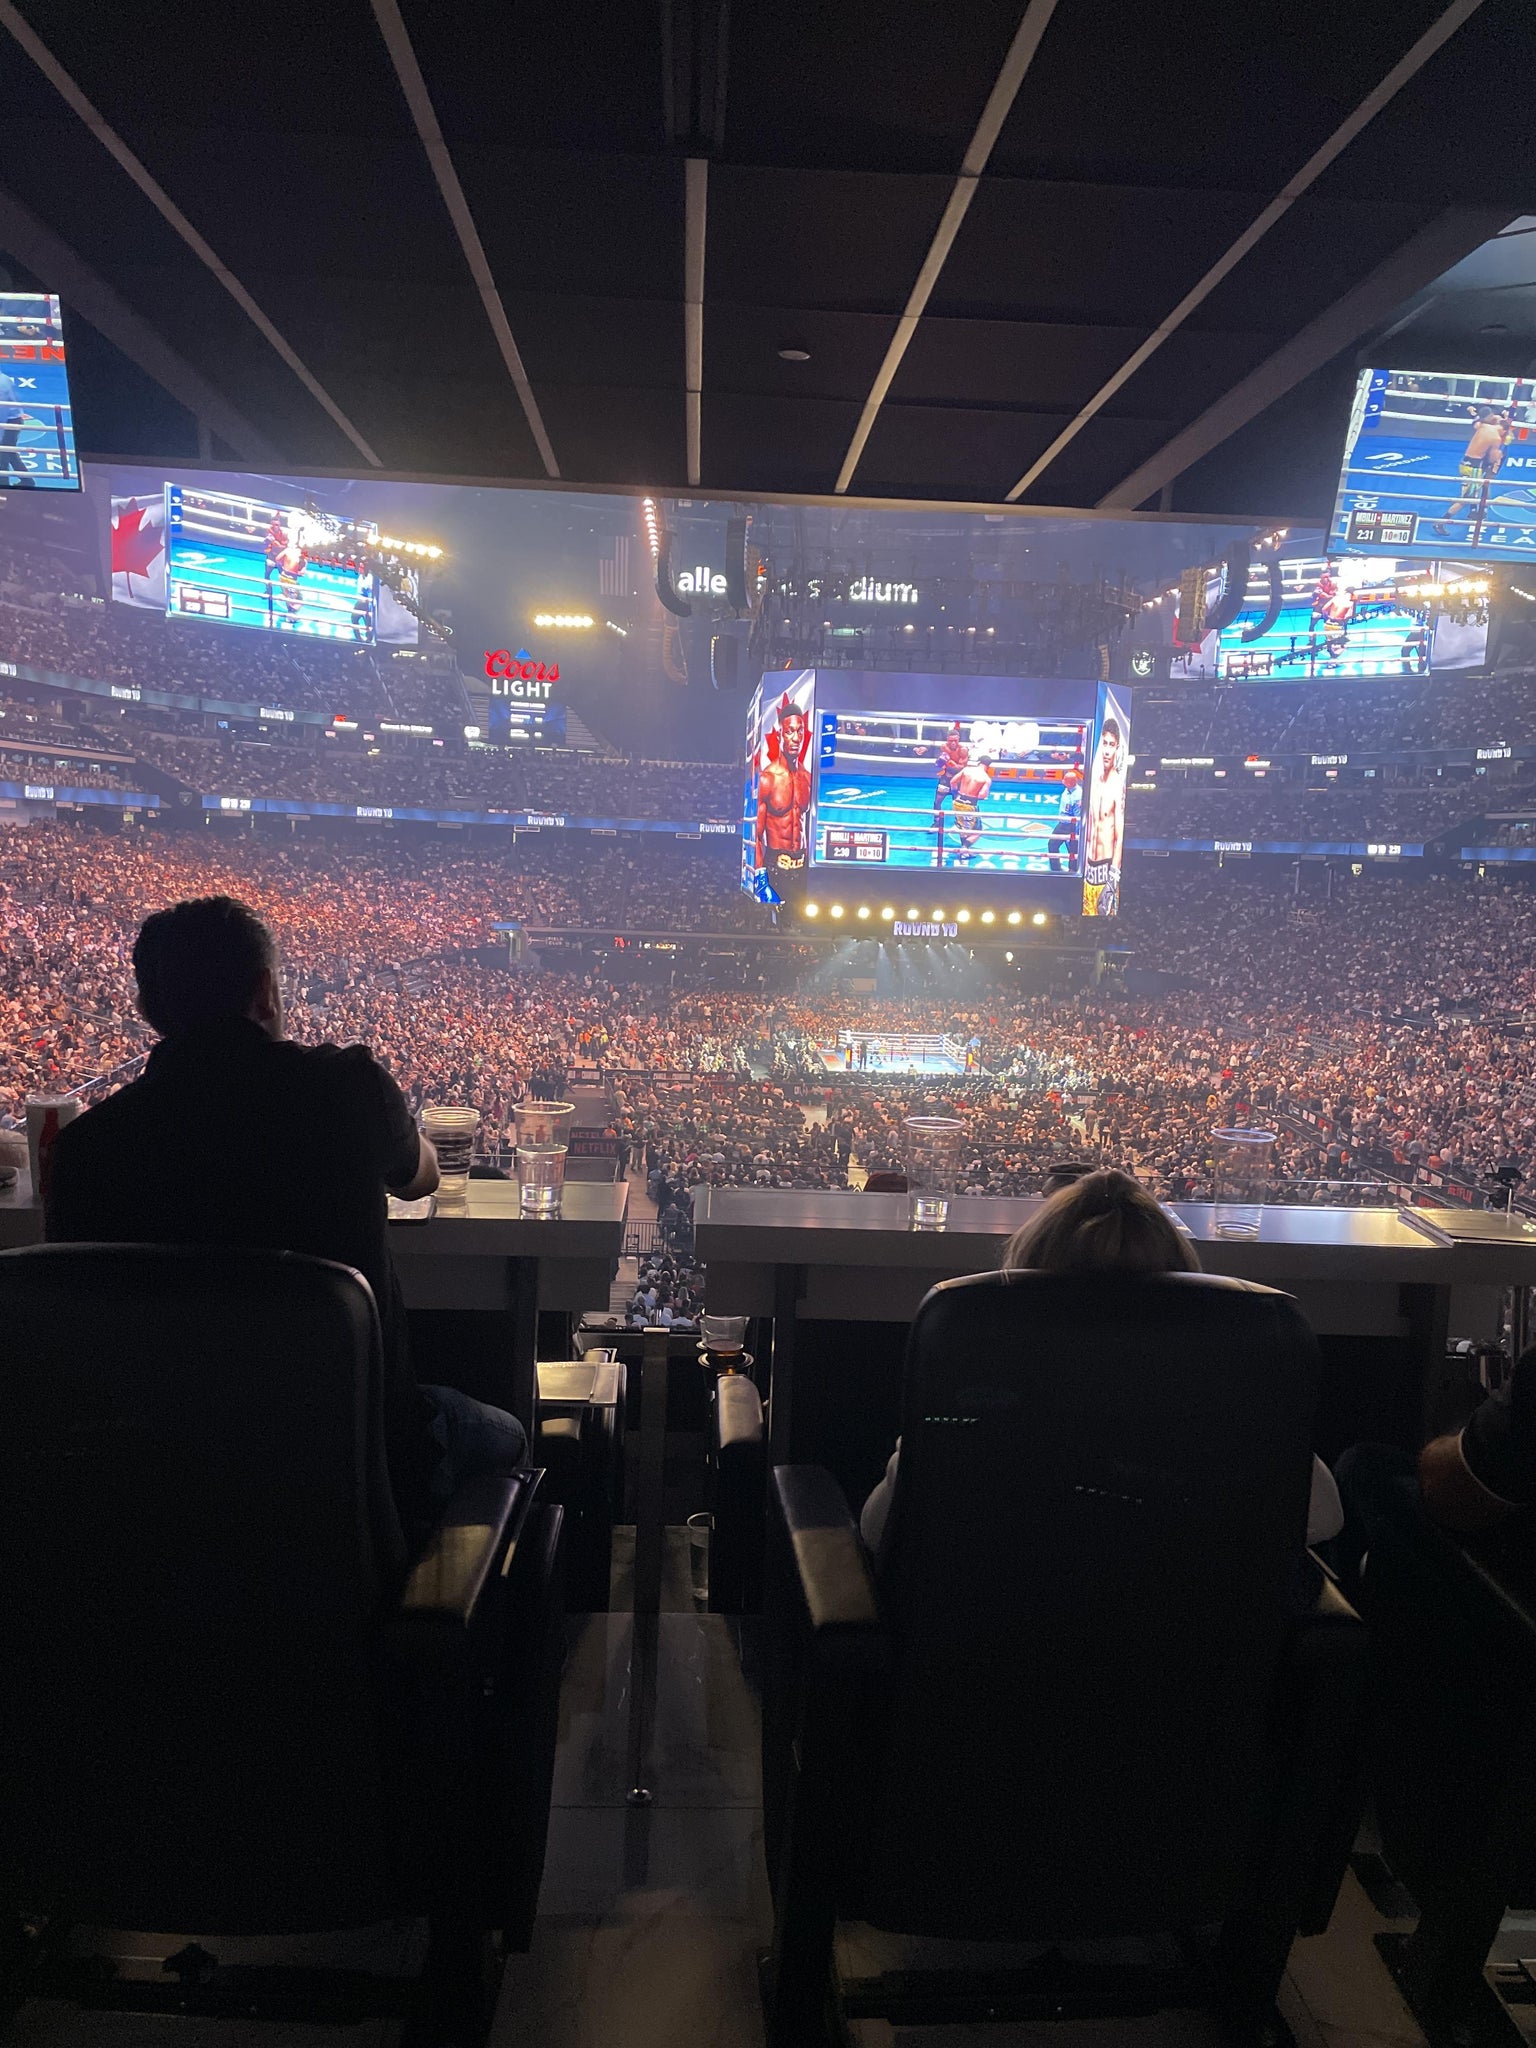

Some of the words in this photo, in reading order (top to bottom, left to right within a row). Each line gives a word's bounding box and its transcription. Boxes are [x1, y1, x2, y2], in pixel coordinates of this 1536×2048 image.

[1381, 513, 1413, 525] MARTINEZ
[484, 649, 560, 682] Coors
[492, 679, 553, 698] LIGHT
[260, 708, 284, 720] ROUND
[1311, 756, 1337, 765] ROUND
[1477, 749, 1503, 760] ROUND
[985, 792, 1060, 805] TFLIX
[357, 806, 383, 818] ROUND
[528, 815, 555, 826] ROUND
[700, 823, 726, 833] ROUND
[1214, 841, 1241, 851] ROUND
[893, 920, 939, 937] ROUND
[573, 1141, 617, 1154] NETFLIX
[1447, 1184, 1474, 1203] NETFLIX
